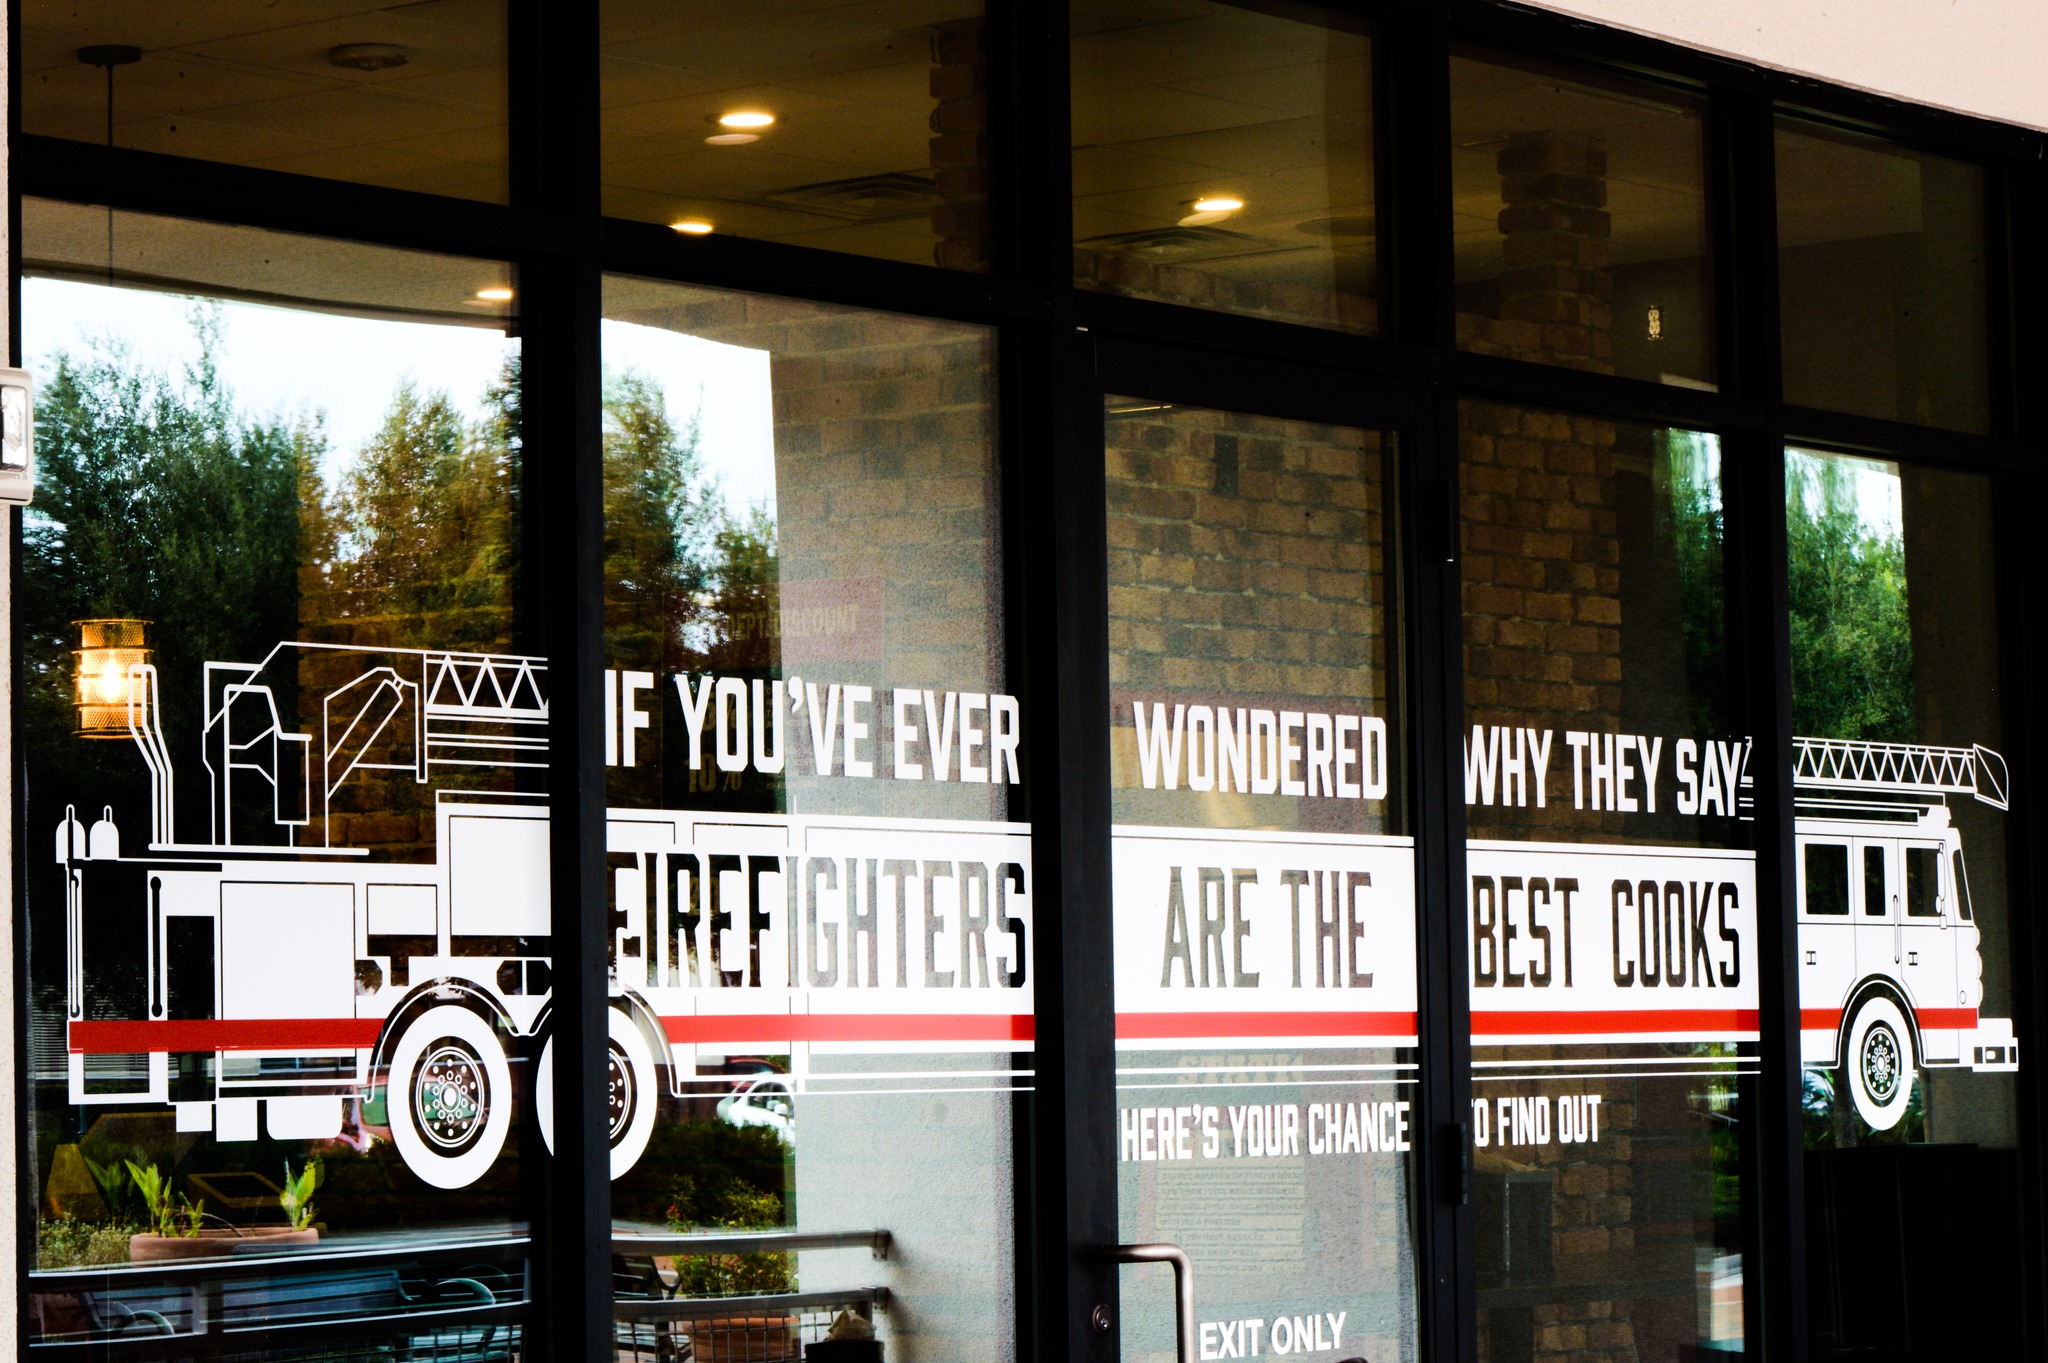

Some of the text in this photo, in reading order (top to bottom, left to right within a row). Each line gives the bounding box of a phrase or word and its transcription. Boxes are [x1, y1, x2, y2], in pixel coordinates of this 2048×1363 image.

[605, 669, 654, 767] IF
[675, 674, 874, 778] YOU'VE
[893, 687, 1021, 784] EVER
[1133, 701, 1388, 800] WONDERED
[1463, 724, 1553, 808] WHY
[1565, 731, 1663, 813] THEY
[1675, 738, 1742, 817] SAY
[607, 851, 1741, 989] FIREFIGHTERS ARE THE BEST COOKS
[1120, 1095, 1602, 1161] HERE'S YOUR CHANCE O FIND OUT
[1199, 1311, 1347, 1361] EXIT ONLY
